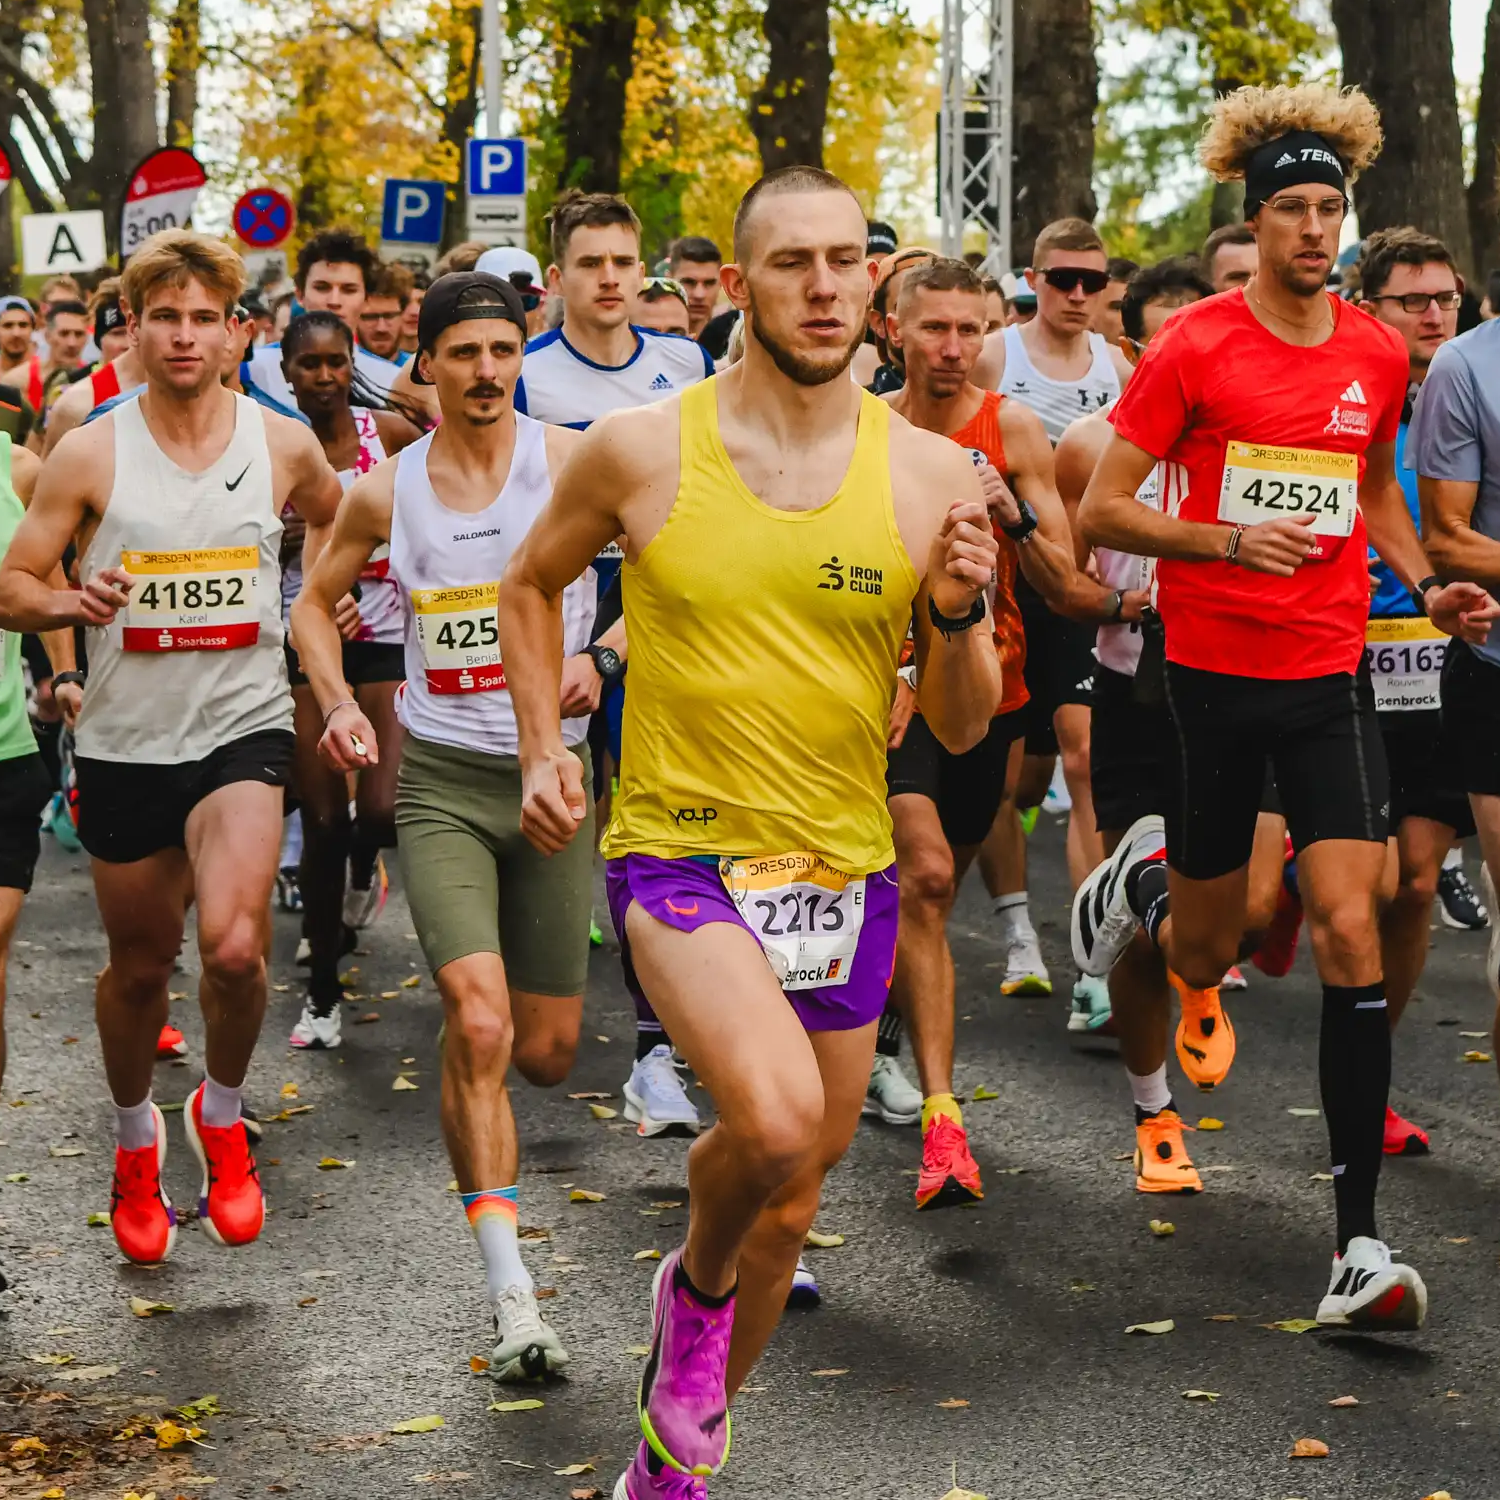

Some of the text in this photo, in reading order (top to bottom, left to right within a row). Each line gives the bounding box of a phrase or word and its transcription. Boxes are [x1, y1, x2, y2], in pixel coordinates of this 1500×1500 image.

[480, 145, 513, 190] P
[395, 187, 431, 234] P
[47, 223, 83, 265] A
[1252, 448, 1298, 462] DRESDEN
[1300, 454, 1350, 468] MARATHON
[1242, 478, 1340, 514] 42524
[452, 528, 501, 542] SALOMON
[144, 549, 251, 564] DRESDEN MARATHON
[850, 566, 883, 582] IRON
[139, 577, 244, 610] 41852
[433, 587, 483, 602] DRESDEN
[850, 580, 883, 595] CLUB
[179, 613, 208, 624] Karel
[436, 617, 498, 650] 425
[1367, 623, 1404, 631] RESDEN
[177, 635, 228, 648] Sparkasse
[1387, 678, 1425, 687] Rouven
[1377, 693, 1436, 707] penbrock
[749, 856, 811, 876] DRESDEN
[854, 891, 862, 905] E
